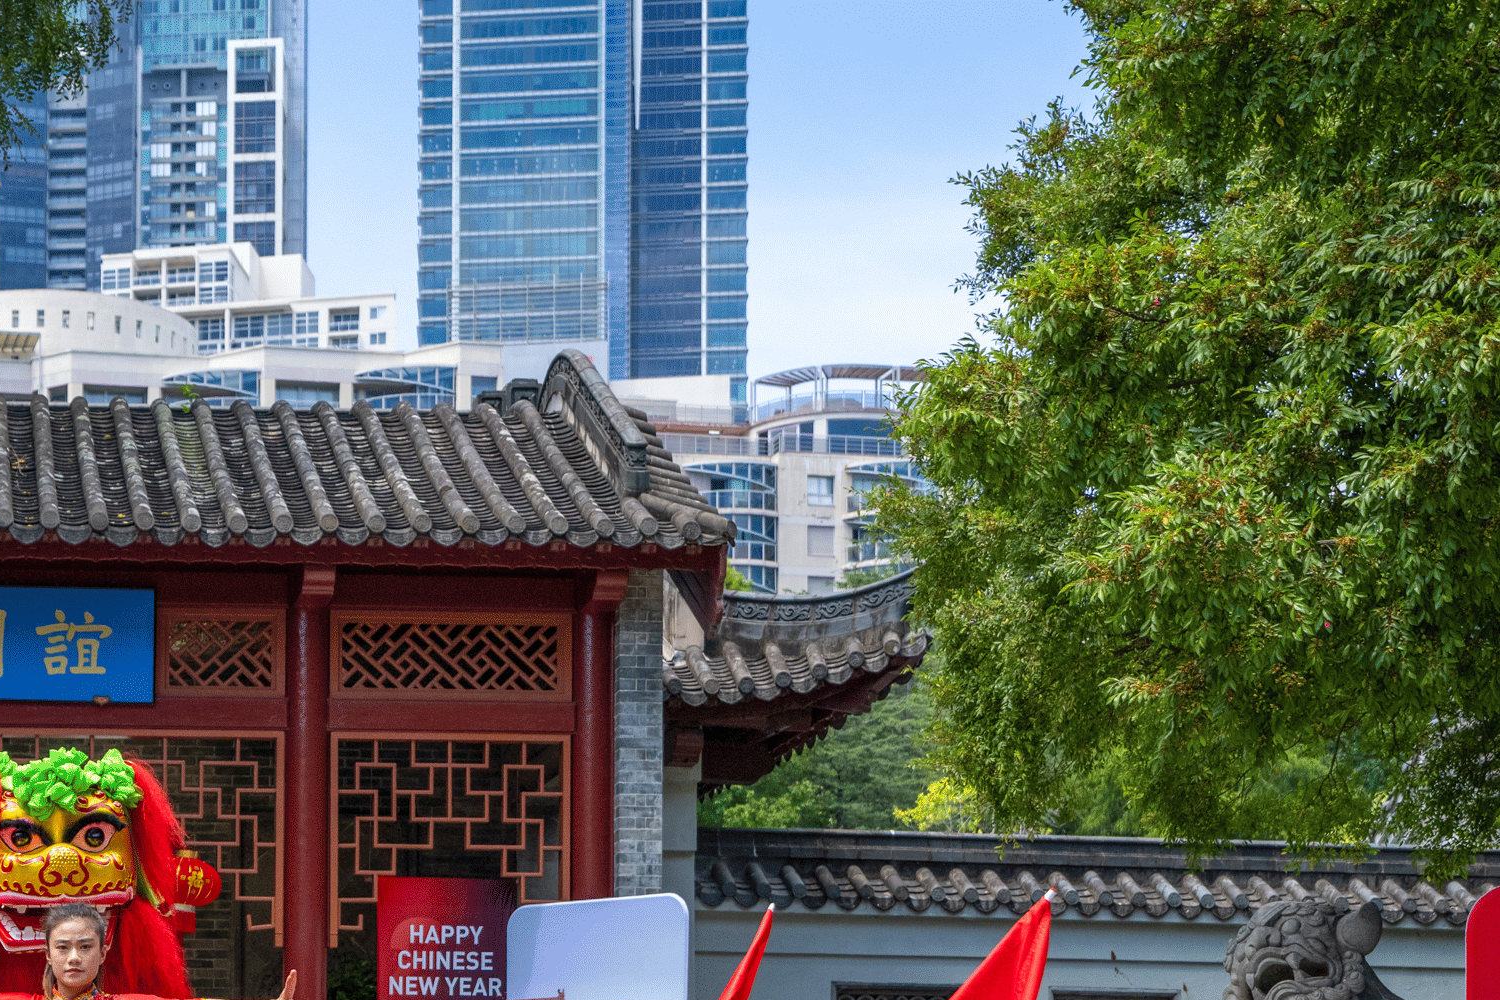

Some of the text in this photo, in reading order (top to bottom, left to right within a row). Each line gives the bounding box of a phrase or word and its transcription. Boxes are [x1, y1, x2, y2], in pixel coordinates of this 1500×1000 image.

[409, 924, 484, 946] HAPPY
[397, 950, 494, 971] CHINESE
[388, 975, 503, 997] NEW YEAR
